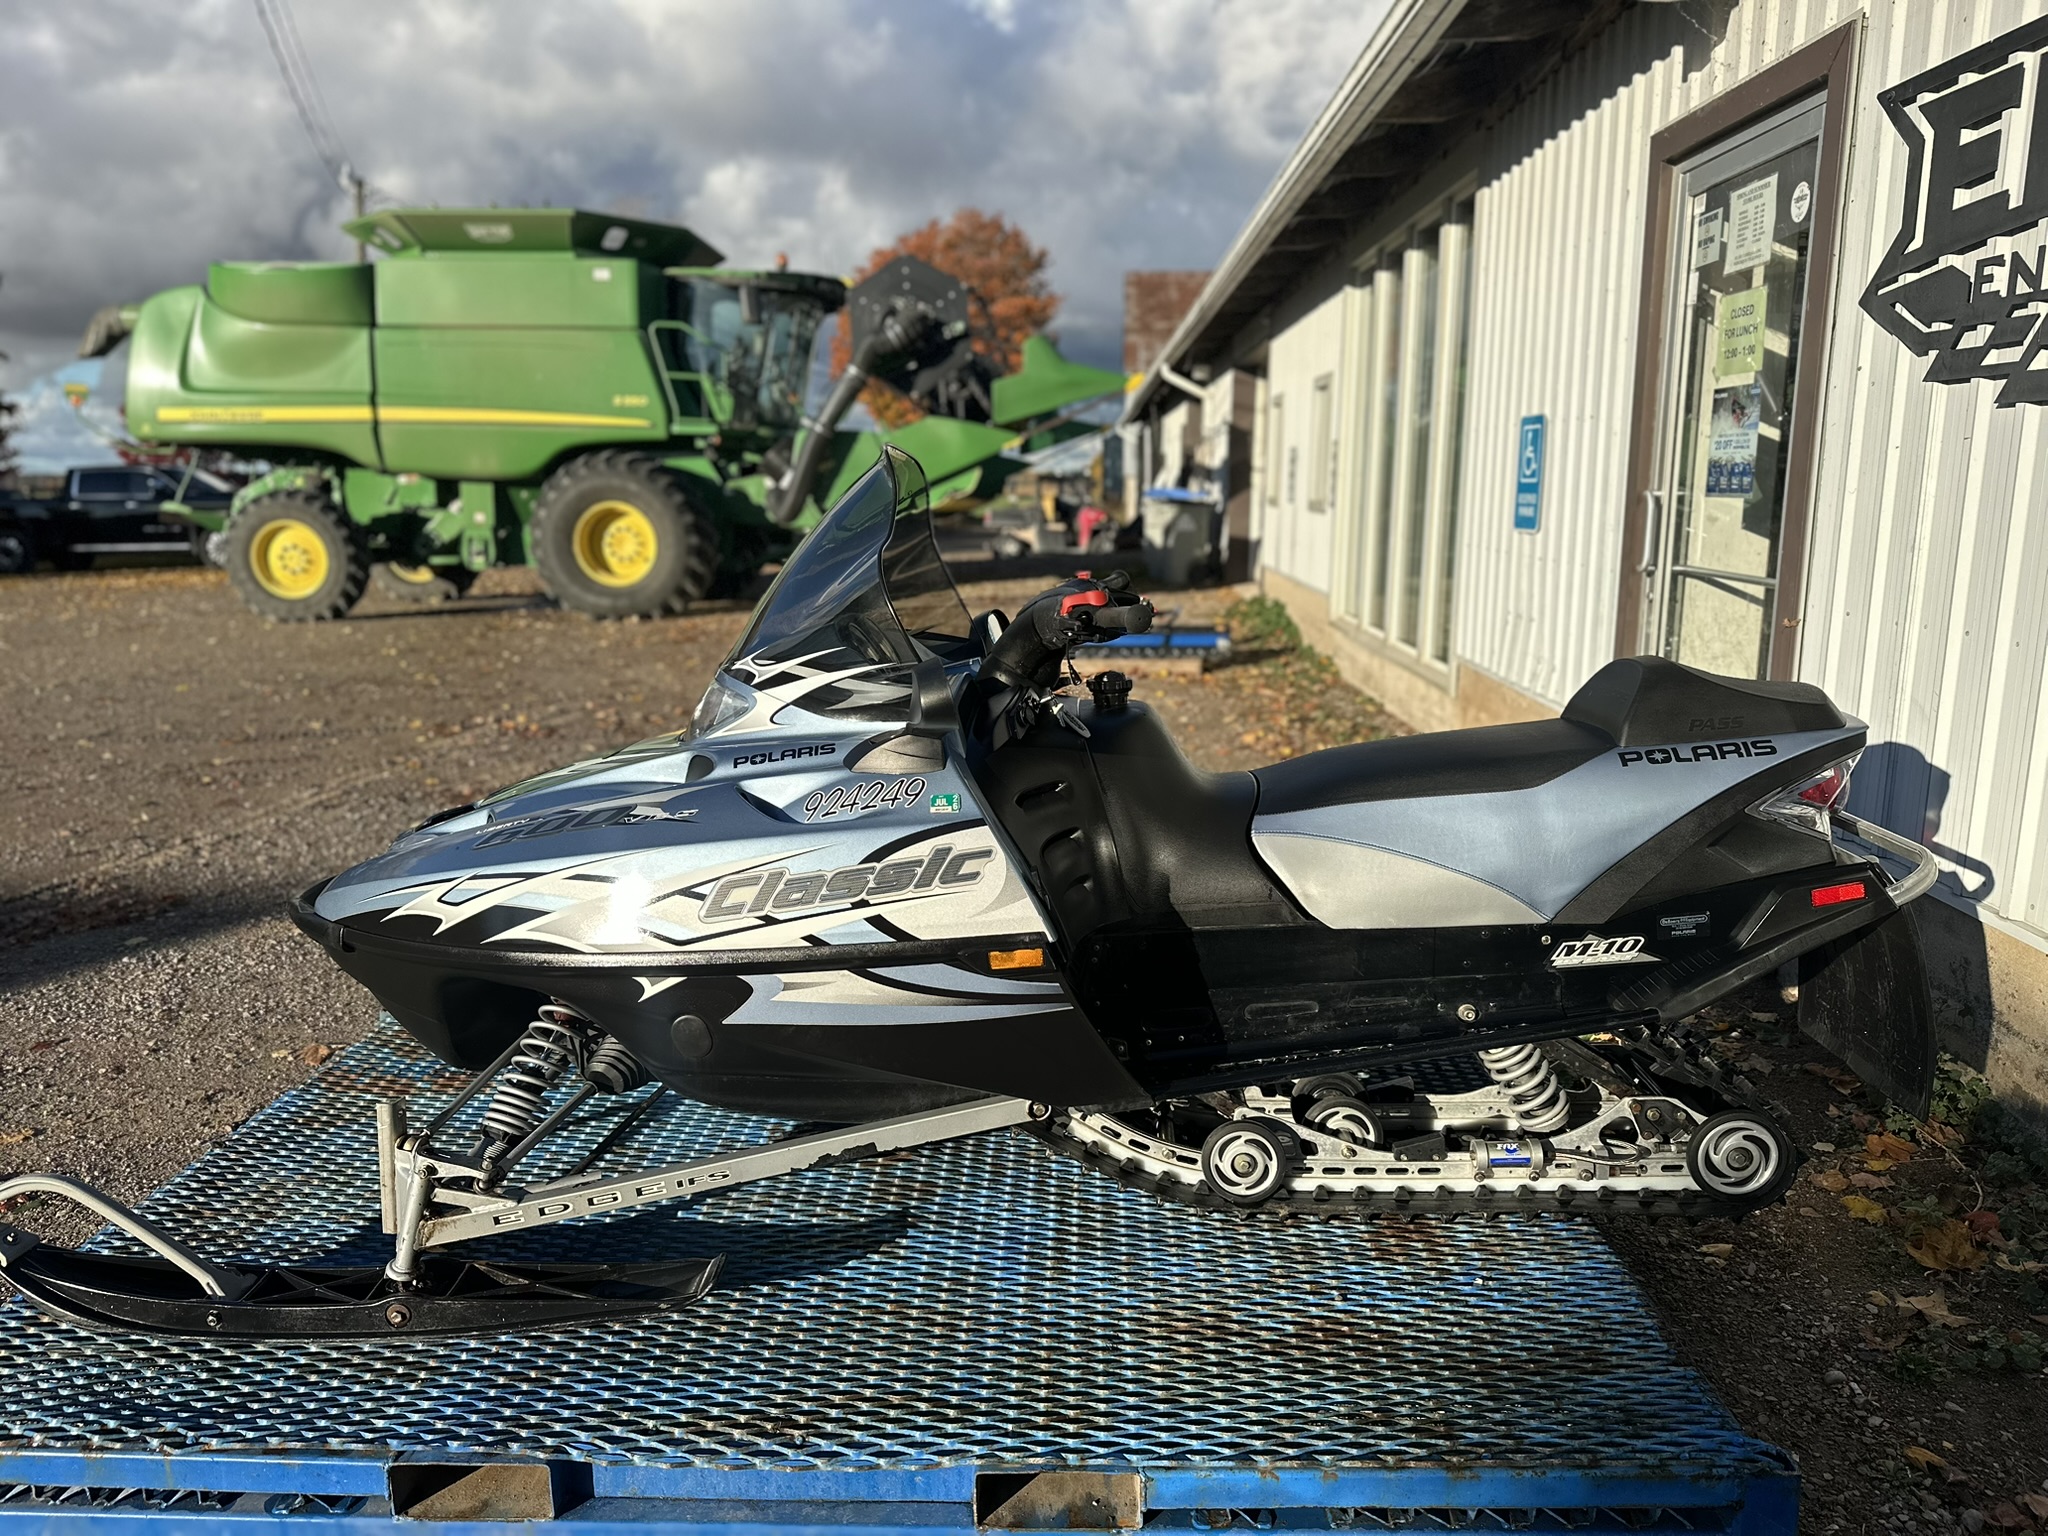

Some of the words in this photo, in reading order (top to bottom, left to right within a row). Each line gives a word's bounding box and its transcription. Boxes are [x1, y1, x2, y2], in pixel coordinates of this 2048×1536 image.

[1730, 303, 1755, 320] CLOSED
[1724, 327, 1736, 340] FOR
[1736, 323, 1759, 338] LUNCH
[1724, 347, 1738, 360] 12:00
[1742, 344, 1756, 356] 1:00
[1688, 716, 1744, 732] PASS
[733, 743, 836, 769] POLARIS
[1617, 739, 1778, 768] POLARIS
[804, 777, 927, 823] 924249
[934, 797, 949, 806] JUL
[475, 818, 530, 835] LIBERTY
[699, 843, 996, 924] Classic
[492, 1181, 667, 1227] EDGE
[676, 1170, 731, 1190] IFS
